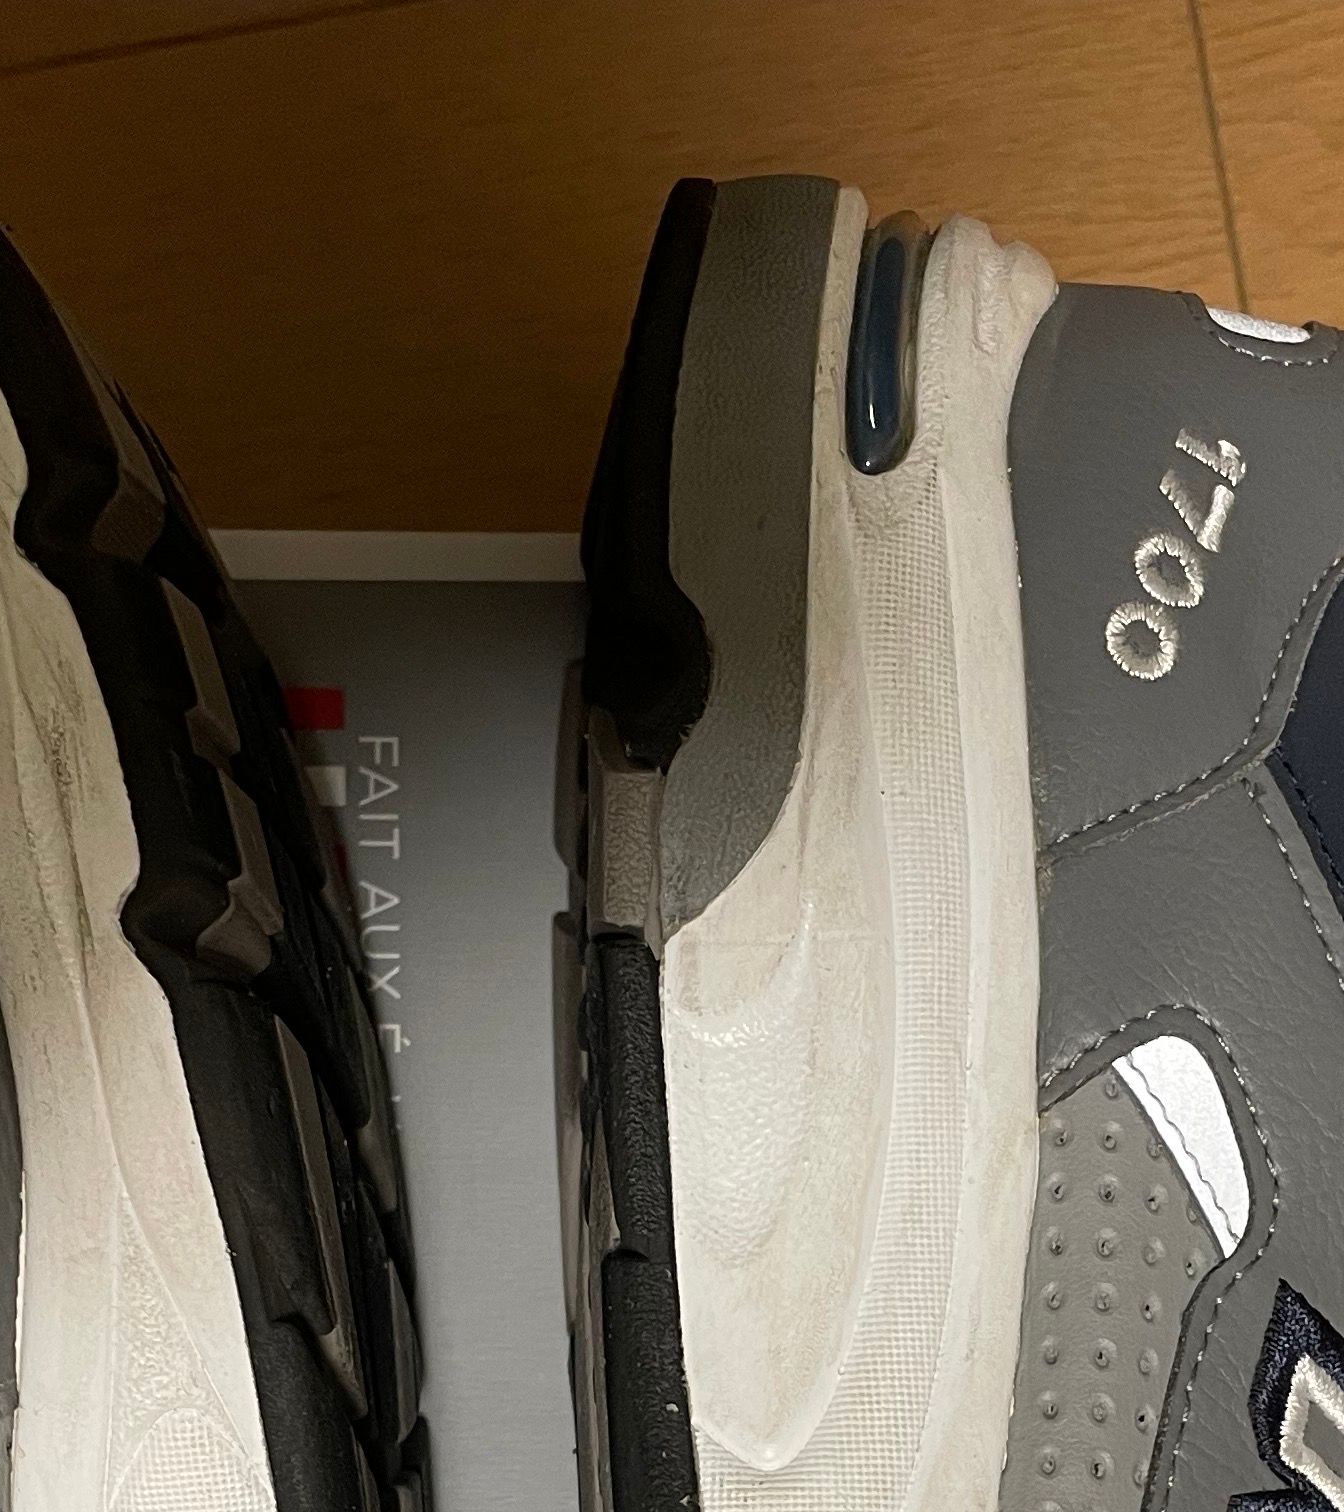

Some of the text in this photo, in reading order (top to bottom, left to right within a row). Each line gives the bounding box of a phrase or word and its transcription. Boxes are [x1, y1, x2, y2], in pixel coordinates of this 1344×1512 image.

[1103, 427, 1247, 682] 1700
[358, 736, 401, 860] FAIT
[359, 881, 402, 1000] AUX
